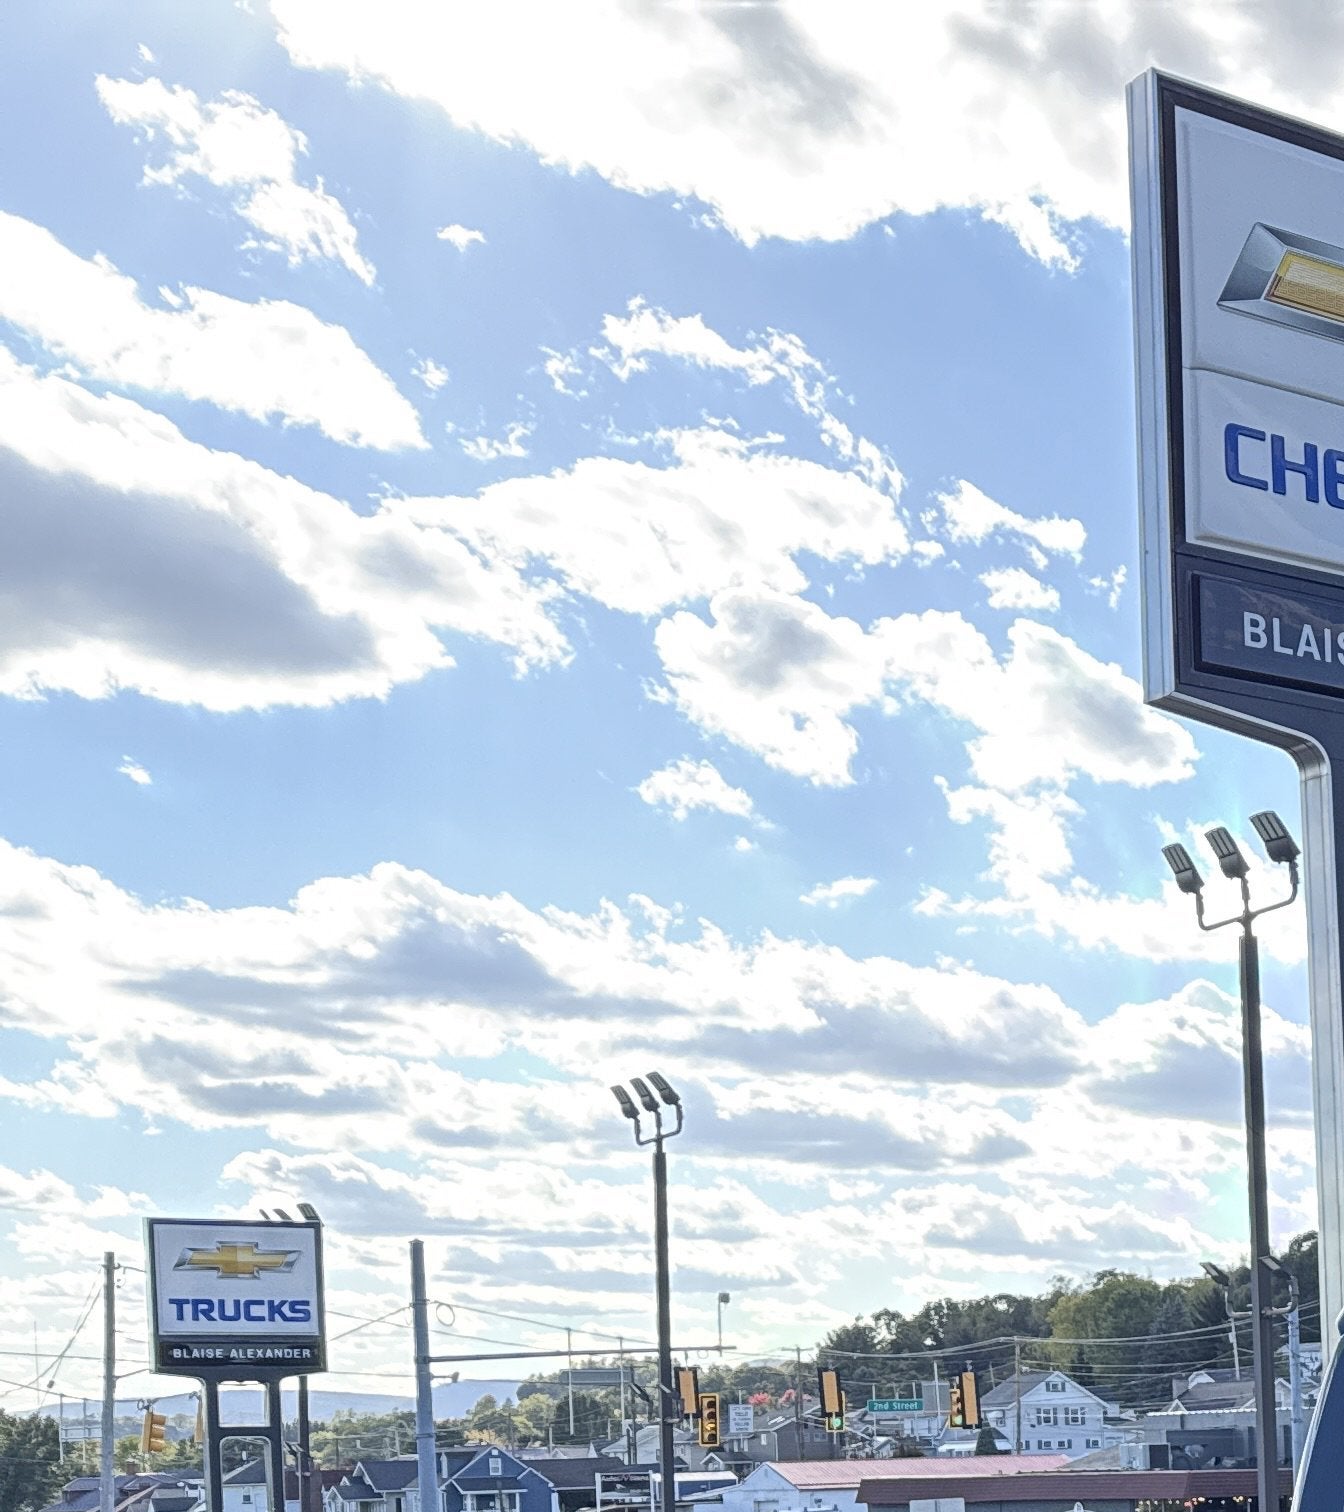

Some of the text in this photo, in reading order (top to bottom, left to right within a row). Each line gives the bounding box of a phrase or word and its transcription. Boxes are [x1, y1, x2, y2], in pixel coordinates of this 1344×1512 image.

[168, 1298, 311, 1322] TRUCKS
[173, 1348, 311, 1359] BLAISE ALEXANDER
[873, 1401, 918, 1410] 2nd Street
